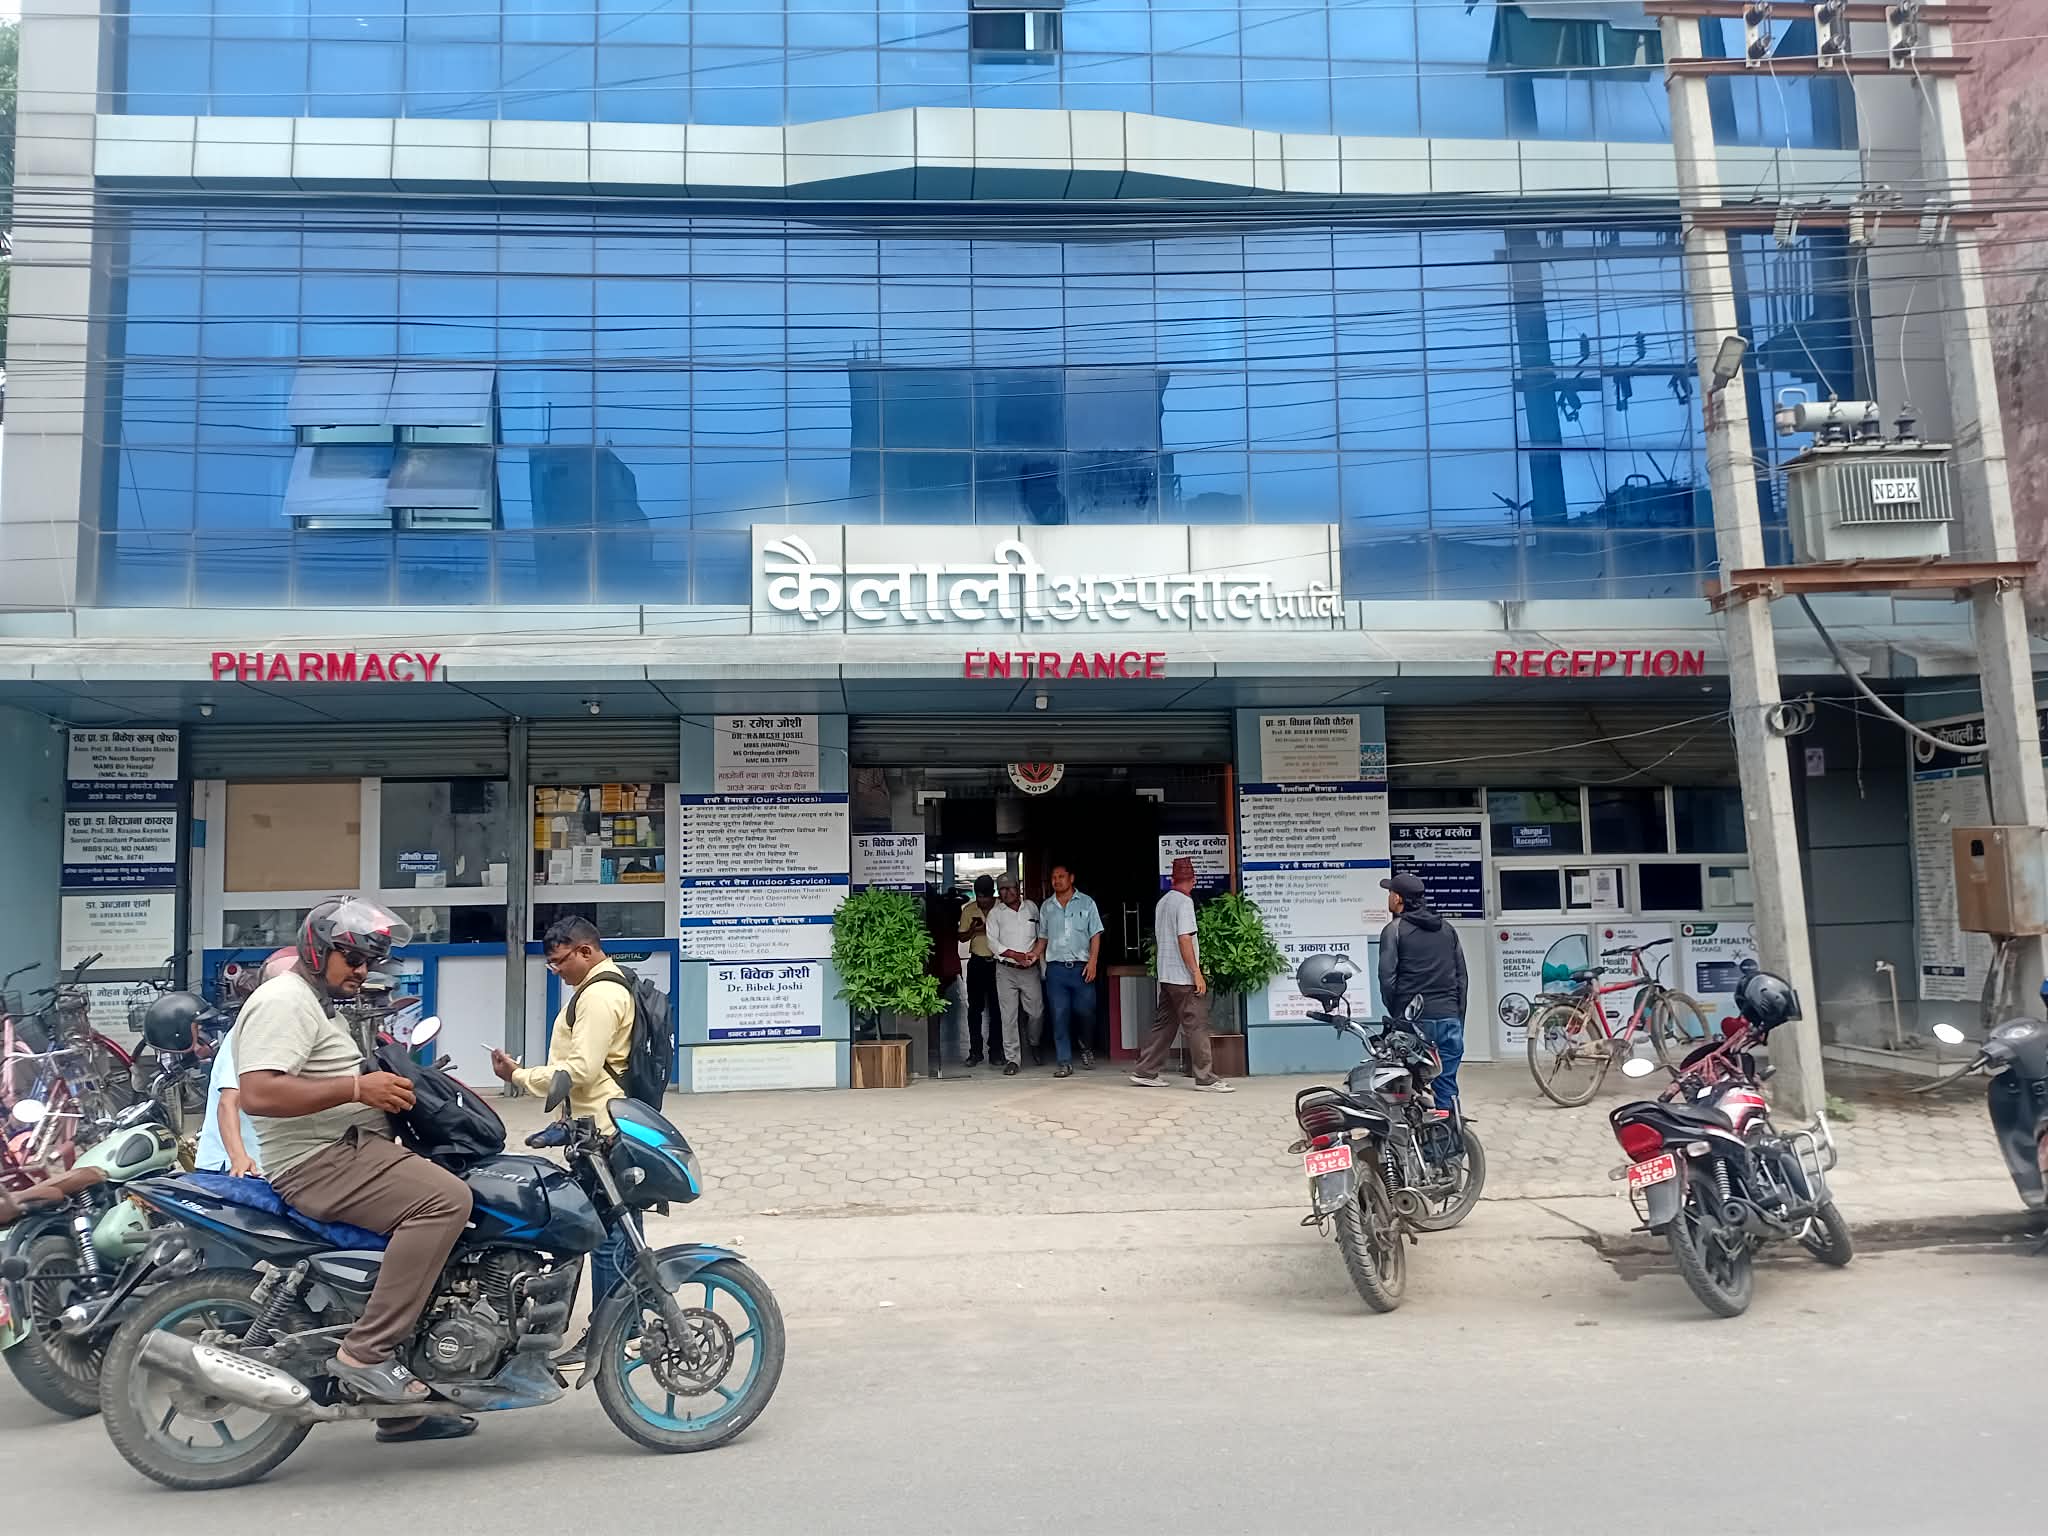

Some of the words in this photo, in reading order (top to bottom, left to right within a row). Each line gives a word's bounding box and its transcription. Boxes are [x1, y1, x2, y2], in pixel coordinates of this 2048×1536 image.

[1874, 482, 1918, 499] NEEK
[764, 534, 1046, 621] कैलाली
[1049, 573, 1272, 620] अस्पताल
[211, 652, 441, 681] PHARMACY
[963, 651, 1166, 679] ENTRANCE
[1493, 649, 1705, 677] RECEPTION
[776, 716, 802, 728] जोशी
[782, 731, 804, 739] JOSHI
[1025, 784, 1049, 792] 2070
[1399, 828, 1412, 838] डा.
[1515, 836, 1549, 845] Reception
[876, 849, 896, 857] Bibek
[895, 849, 914, 858] Joshi
[400, 863, 437, 871] Pharmacy
[1720, 937, 1753, 945] HEALTH
[1284, 944, 1296, 952] डा.
[1602, 957, 1628, 966] Health
[719, 971, 736, 981] डा.
[778, 965, 810, 979] जोशी
[1603, 966, 1635, 976] Packag
[727, 984, 743, 992] Dr.
[746, 983, 776, 992] Bibek
[776, 981, 803, 993] Joshi
